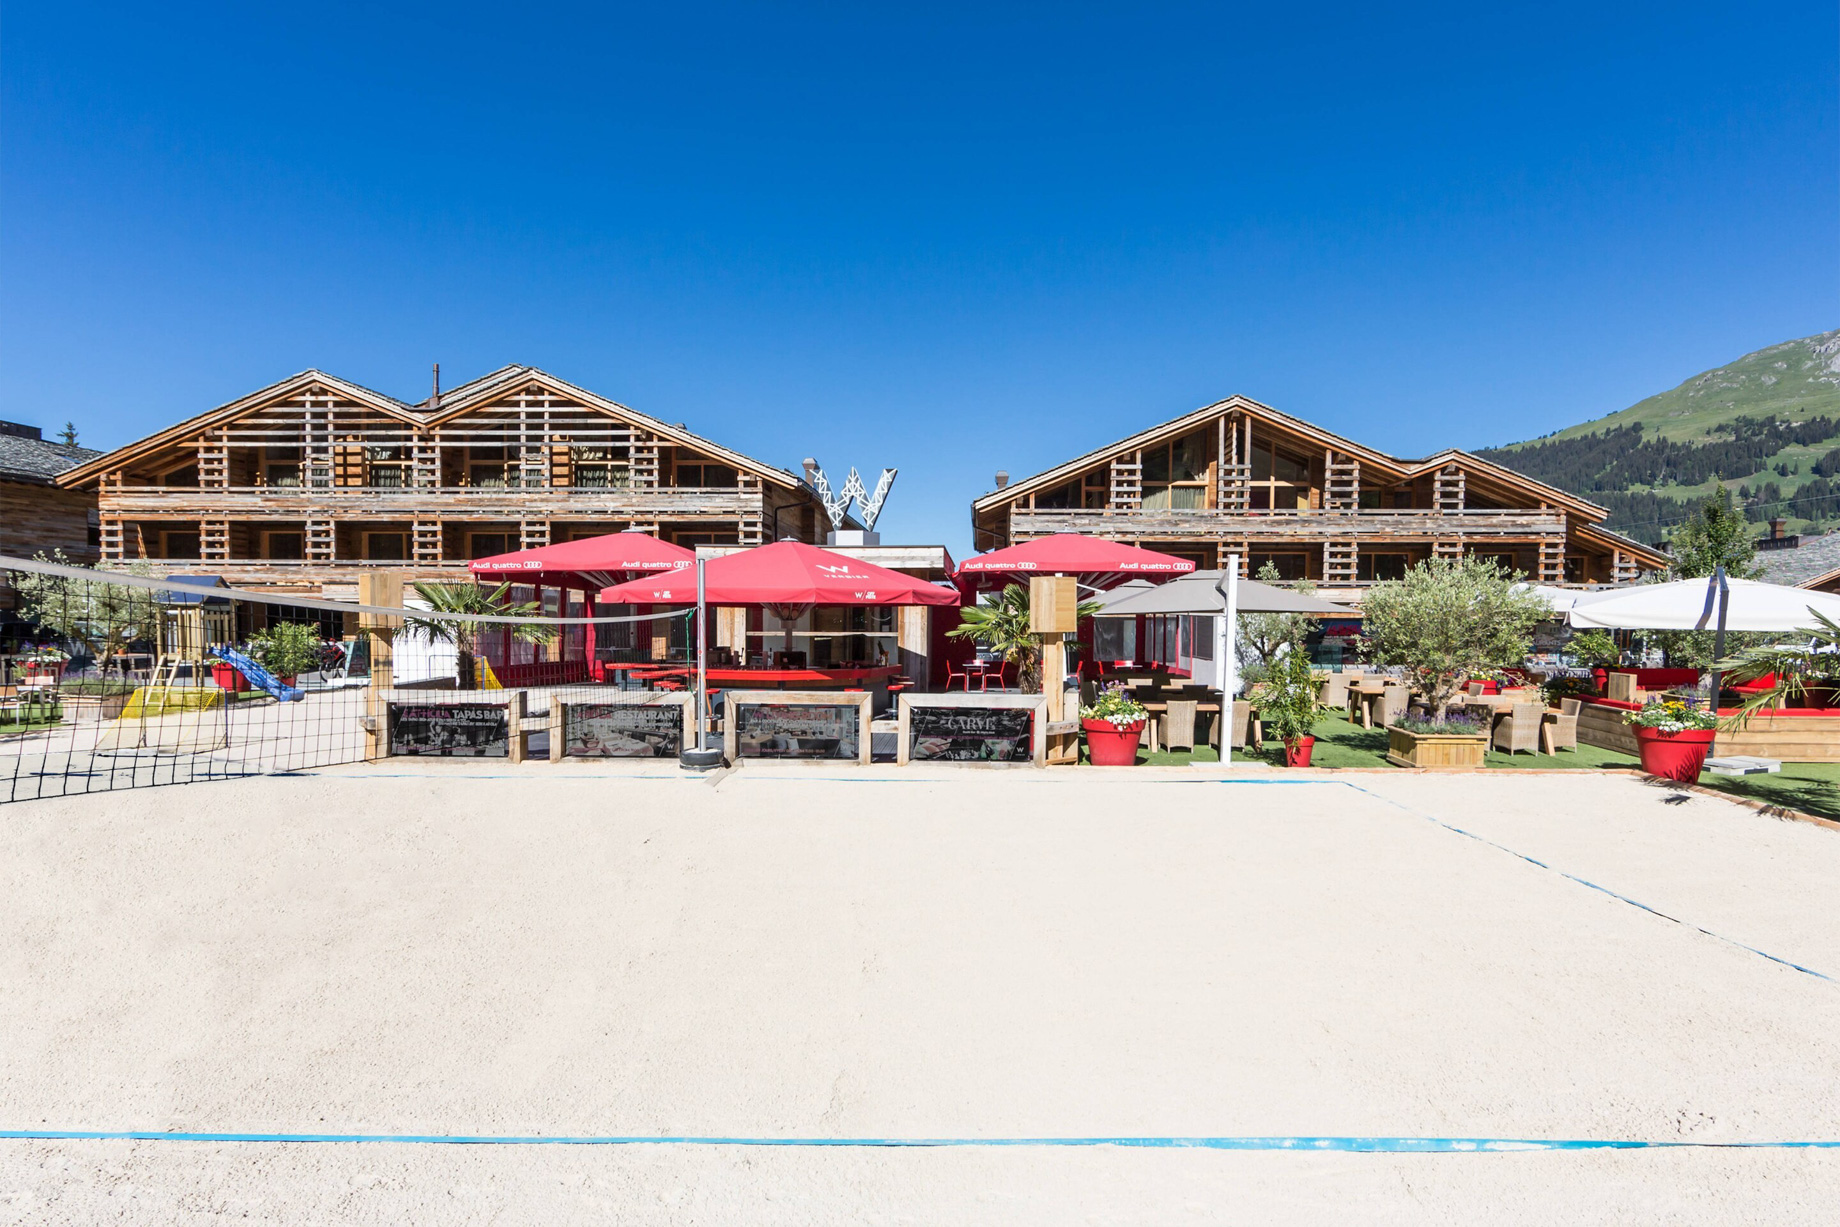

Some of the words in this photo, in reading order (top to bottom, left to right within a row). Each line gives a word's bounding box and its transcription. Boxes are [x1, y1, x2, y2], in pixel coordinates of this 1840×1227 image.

[472, 561, 490, 569] Audi
[492, 562, 522, 570] quattro
[642, 561, 672, 569] quattro
[985, 562, 1016, 570] quattro
[1140, 563, 1171, 571] quattro
[452, 709, 483, 720] TAPAS
[614, 709, 678, 720] RESTAURANT
[947, 717, 996, 731] CARVE
